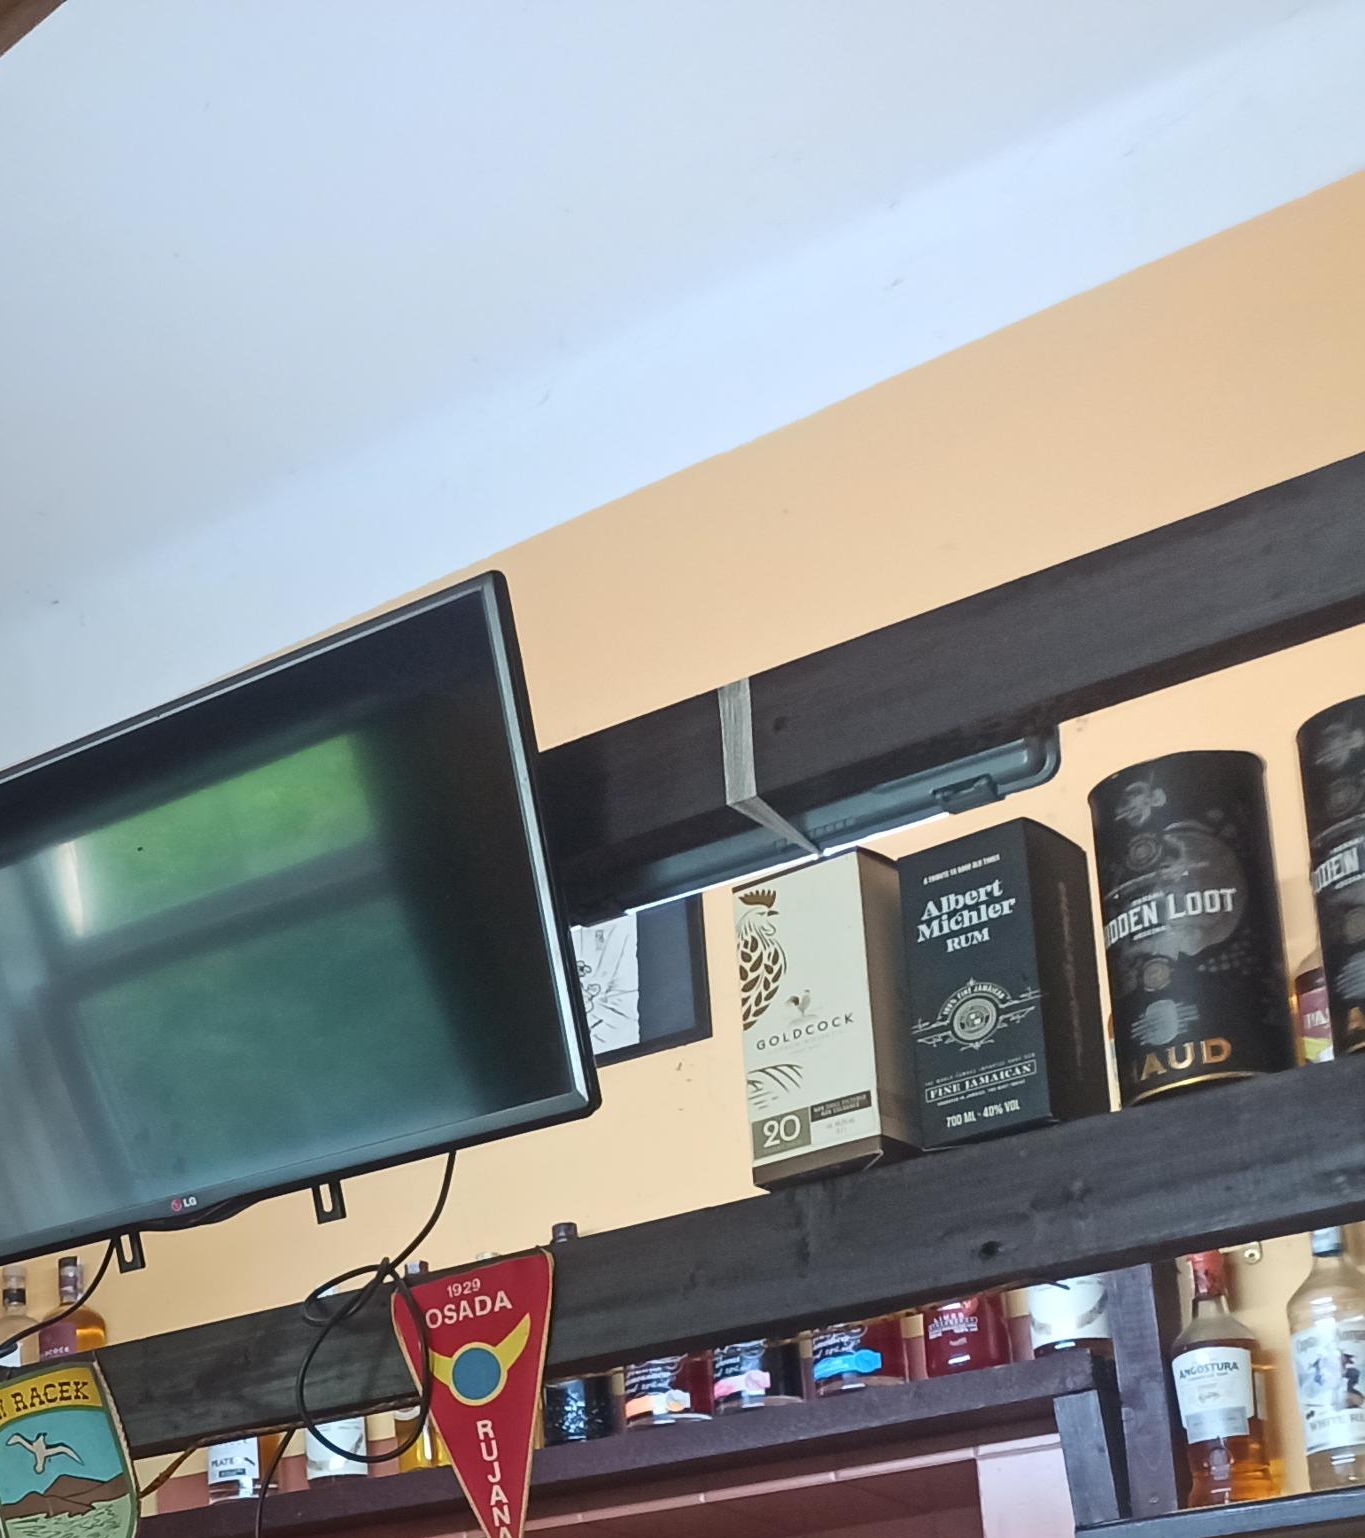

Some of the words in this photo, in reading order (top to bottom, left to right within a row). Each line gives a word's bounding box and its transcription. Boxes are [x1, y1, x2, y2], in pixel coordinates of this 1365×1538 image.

[921, 879, 1003, 921] Albert
[1169, 887, 1237, 920] LOOT
[917, 897, 1016, 943] Michler
[945, 927, 990, 953] RUM
[756, 1012, 855, 1051] GOLDCOCK
[929, 1083, 962, 1100] FINE
[964, 1062, 1033, 1091] JAMAICAN
[946, 1113, 962, 1128] 700
[982, 1103, 1004, 1118] 40%
[1004, 1099, 1021, 1112] VOL
[762, 1114, 802, 1148] 20
[183, 1196, 197, 1208] LG
[446, 1277, 482, 1299] 1929
[424, 1289, 513, 1331] OSADA
[1178, 1360, 1240, 1381] ANGOSTURA
[11, 1380, 90, 1413] RACEK
